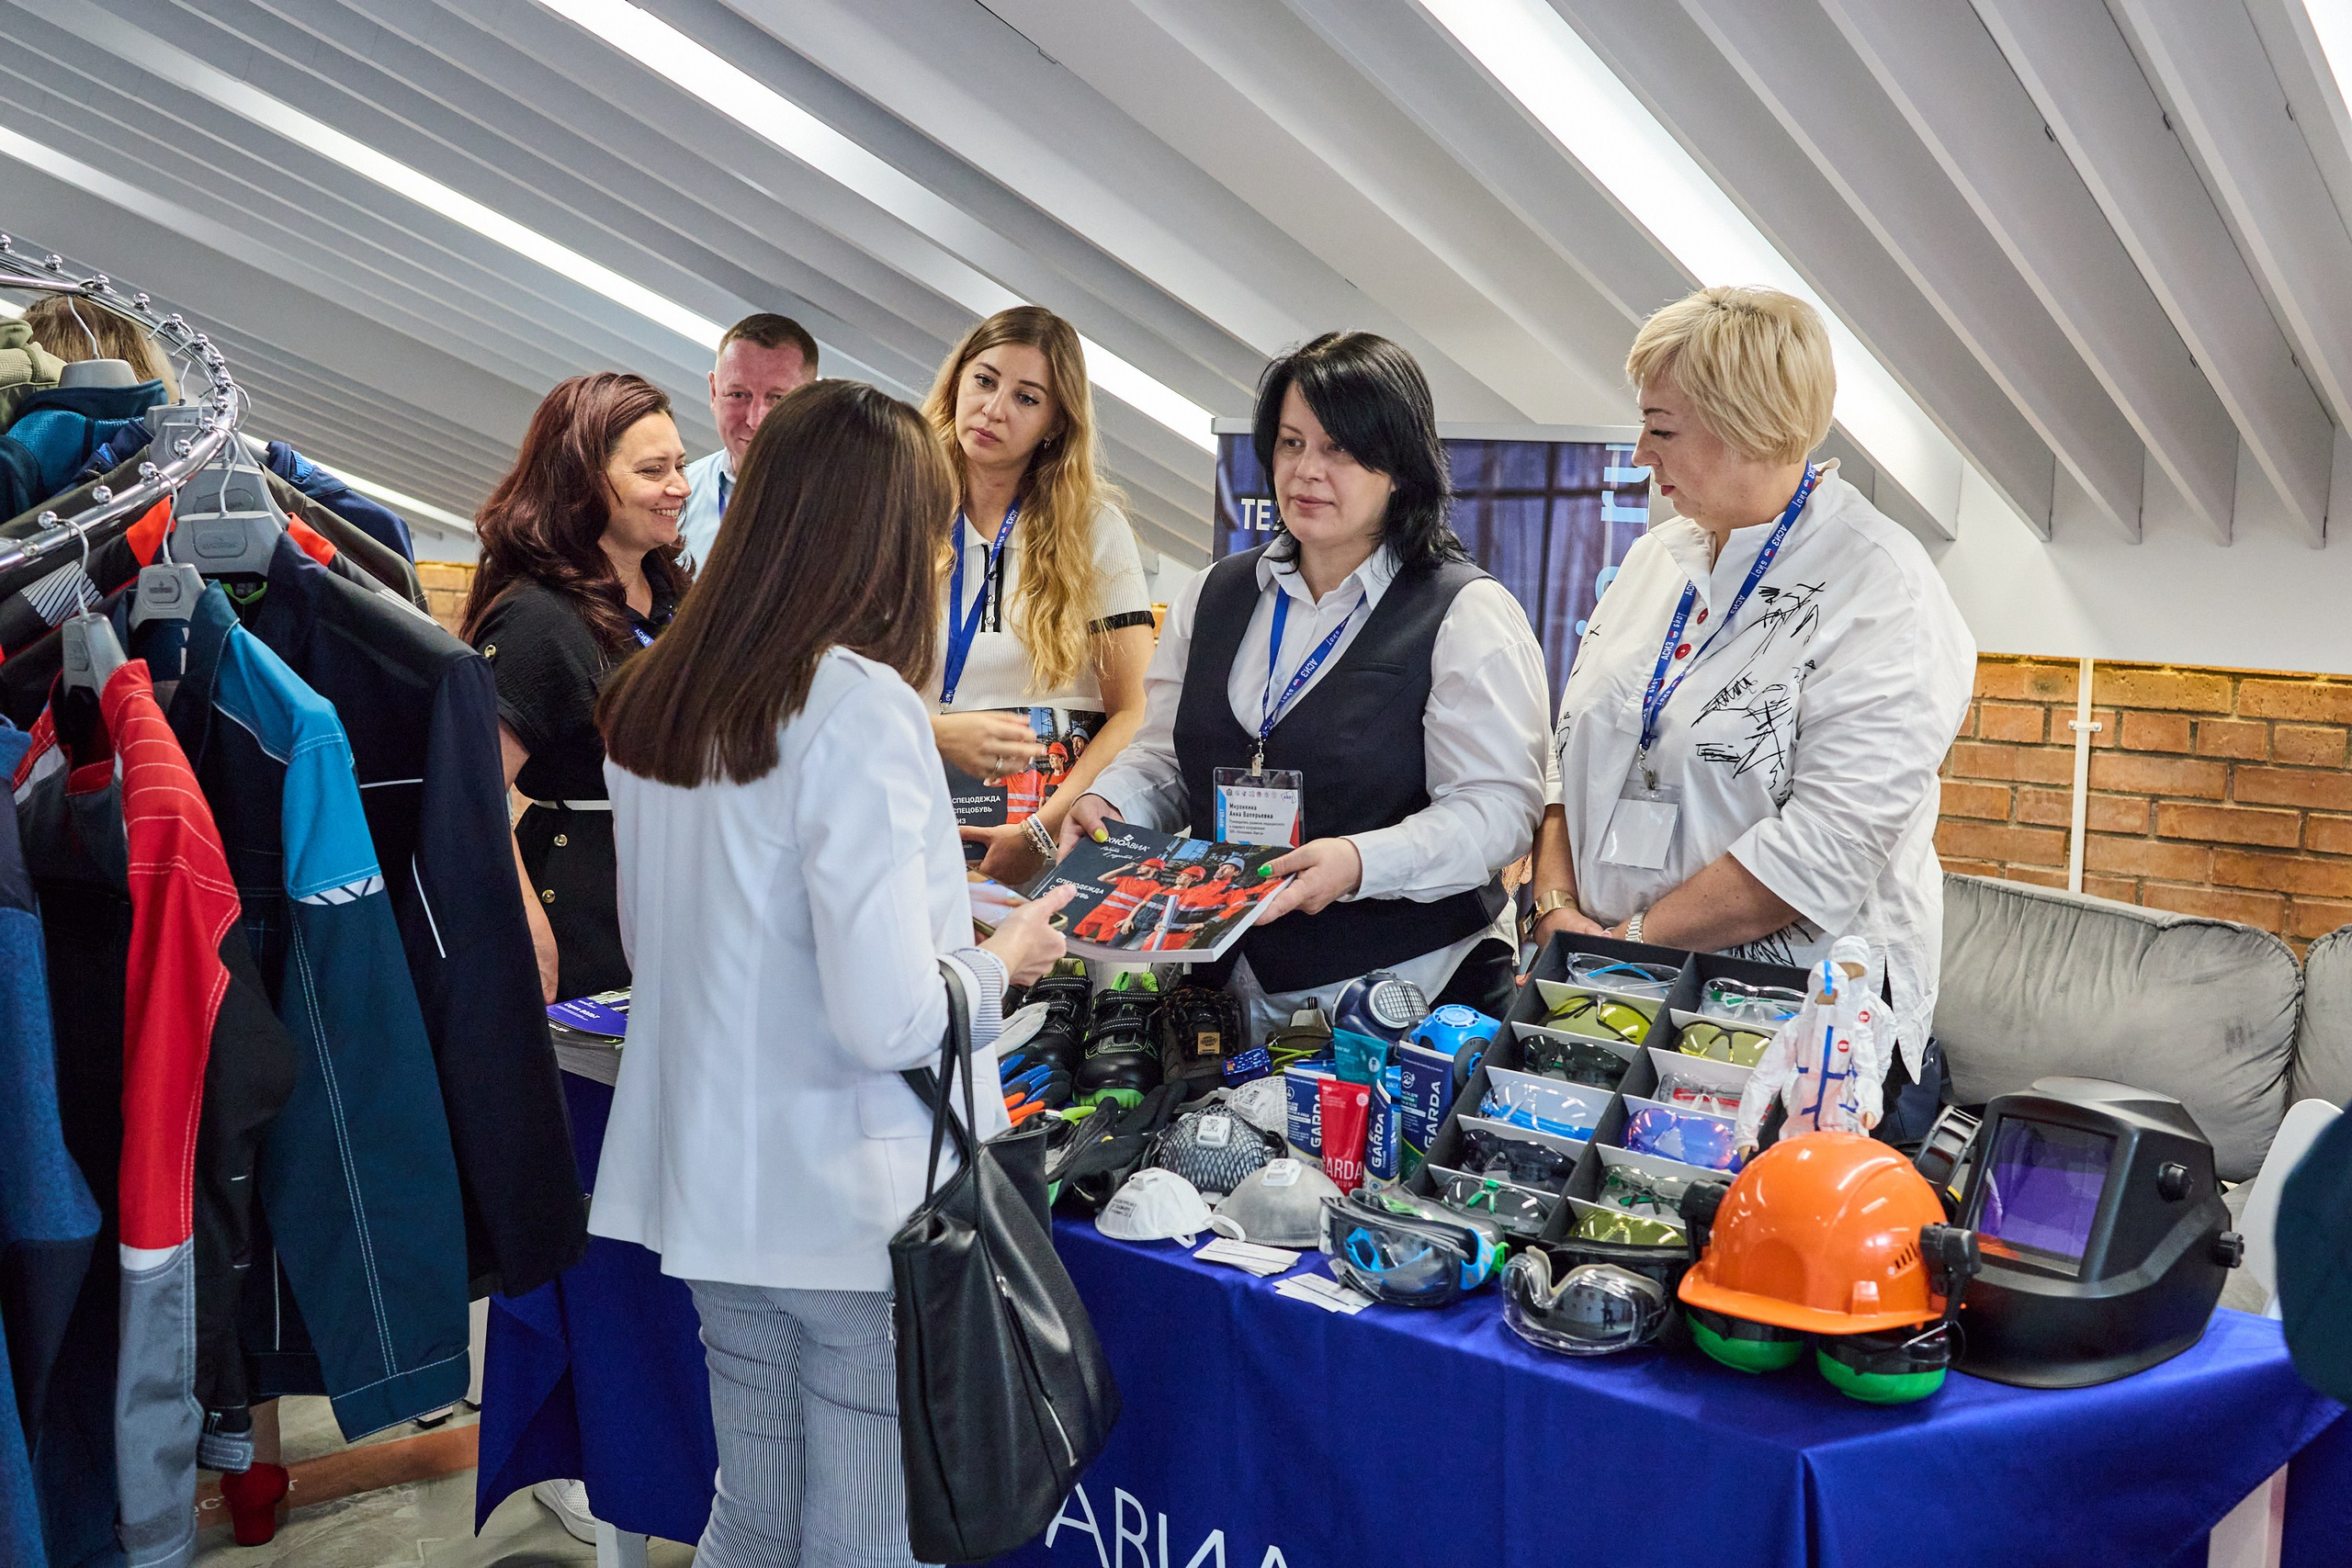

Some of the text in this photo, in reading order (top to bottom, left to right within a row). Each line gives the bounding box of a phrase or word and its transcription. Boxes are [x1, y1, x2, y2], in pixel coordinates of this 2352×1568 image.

[1771, 524, 1788, 547] АСИЗ
[634, 628, 650, 645] АСИЗ
[1660, 641, 1675, 660] АСИЗ
[1300, 658, 1318, 679] АСИЗ
[952, 795, 1001, 805] СПЕЦОДЕЖДА
[1106, 836, 1148, 852] ХНОАВИА
[1424, 1080, 1442, 1149] GARDA
[1372, 1112, 1385, 1168] GARDA
[1045, 1481, 1289, 1568] АВИ
